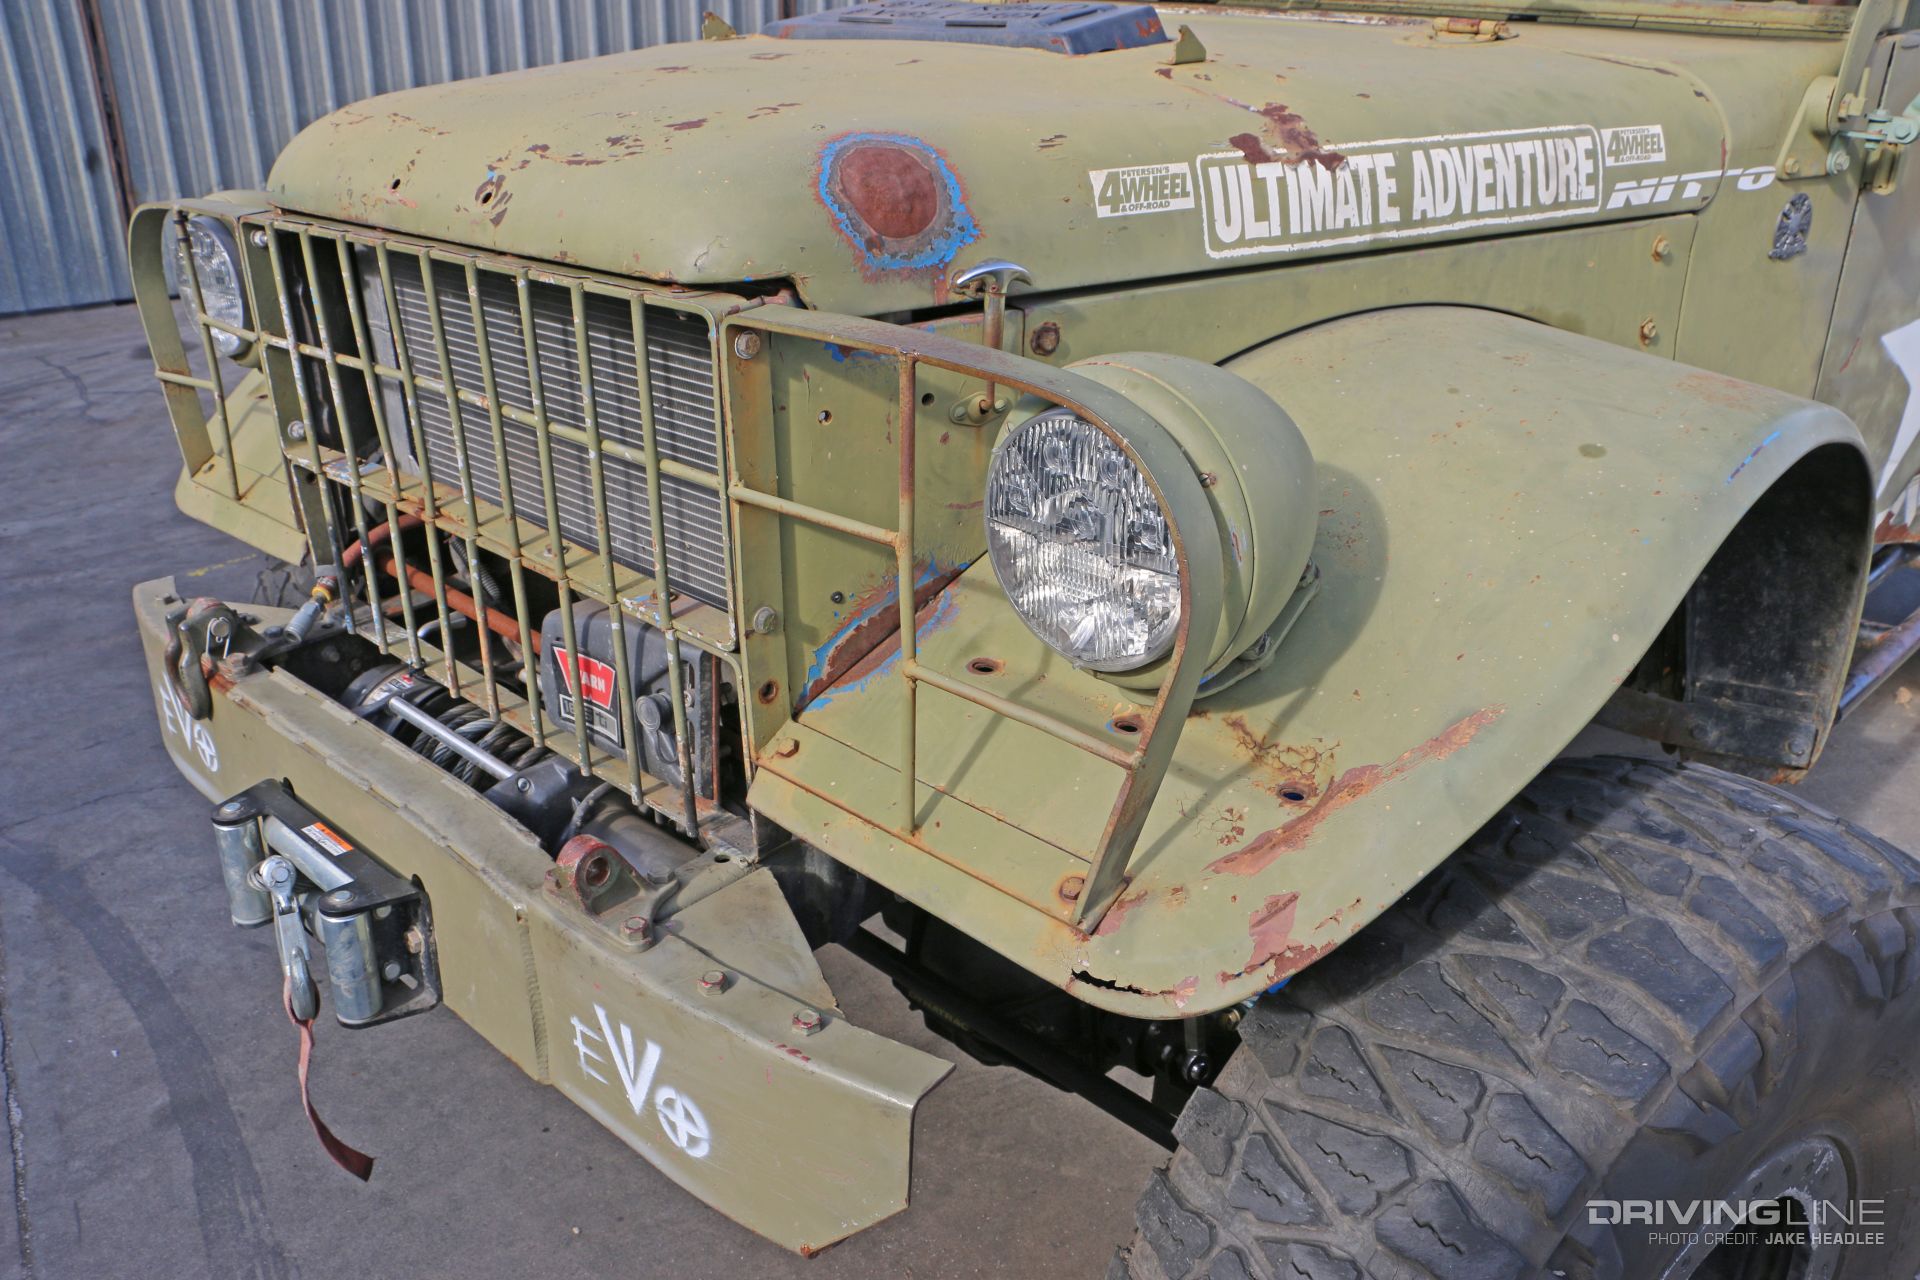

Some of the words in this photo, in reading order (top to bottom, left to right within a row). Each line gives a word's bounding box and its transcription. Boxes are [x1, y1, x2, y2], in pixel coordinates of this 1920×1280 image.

[1606, 129, 1624, 163] 4
[1620, 132, 1663, 155] WHEEL
[1120, 166, 1170, 177] PETERSEN'S
[1098, 171, 1124, 213] 4
[1121, 172, 1190, 204] WHEEL
[1128, 200, 1170, 212] OFF-ROAD
[1208, 152, 1401, 243] ULTIMATE
[1412, 135, 1596, 220] ADVENTURE
